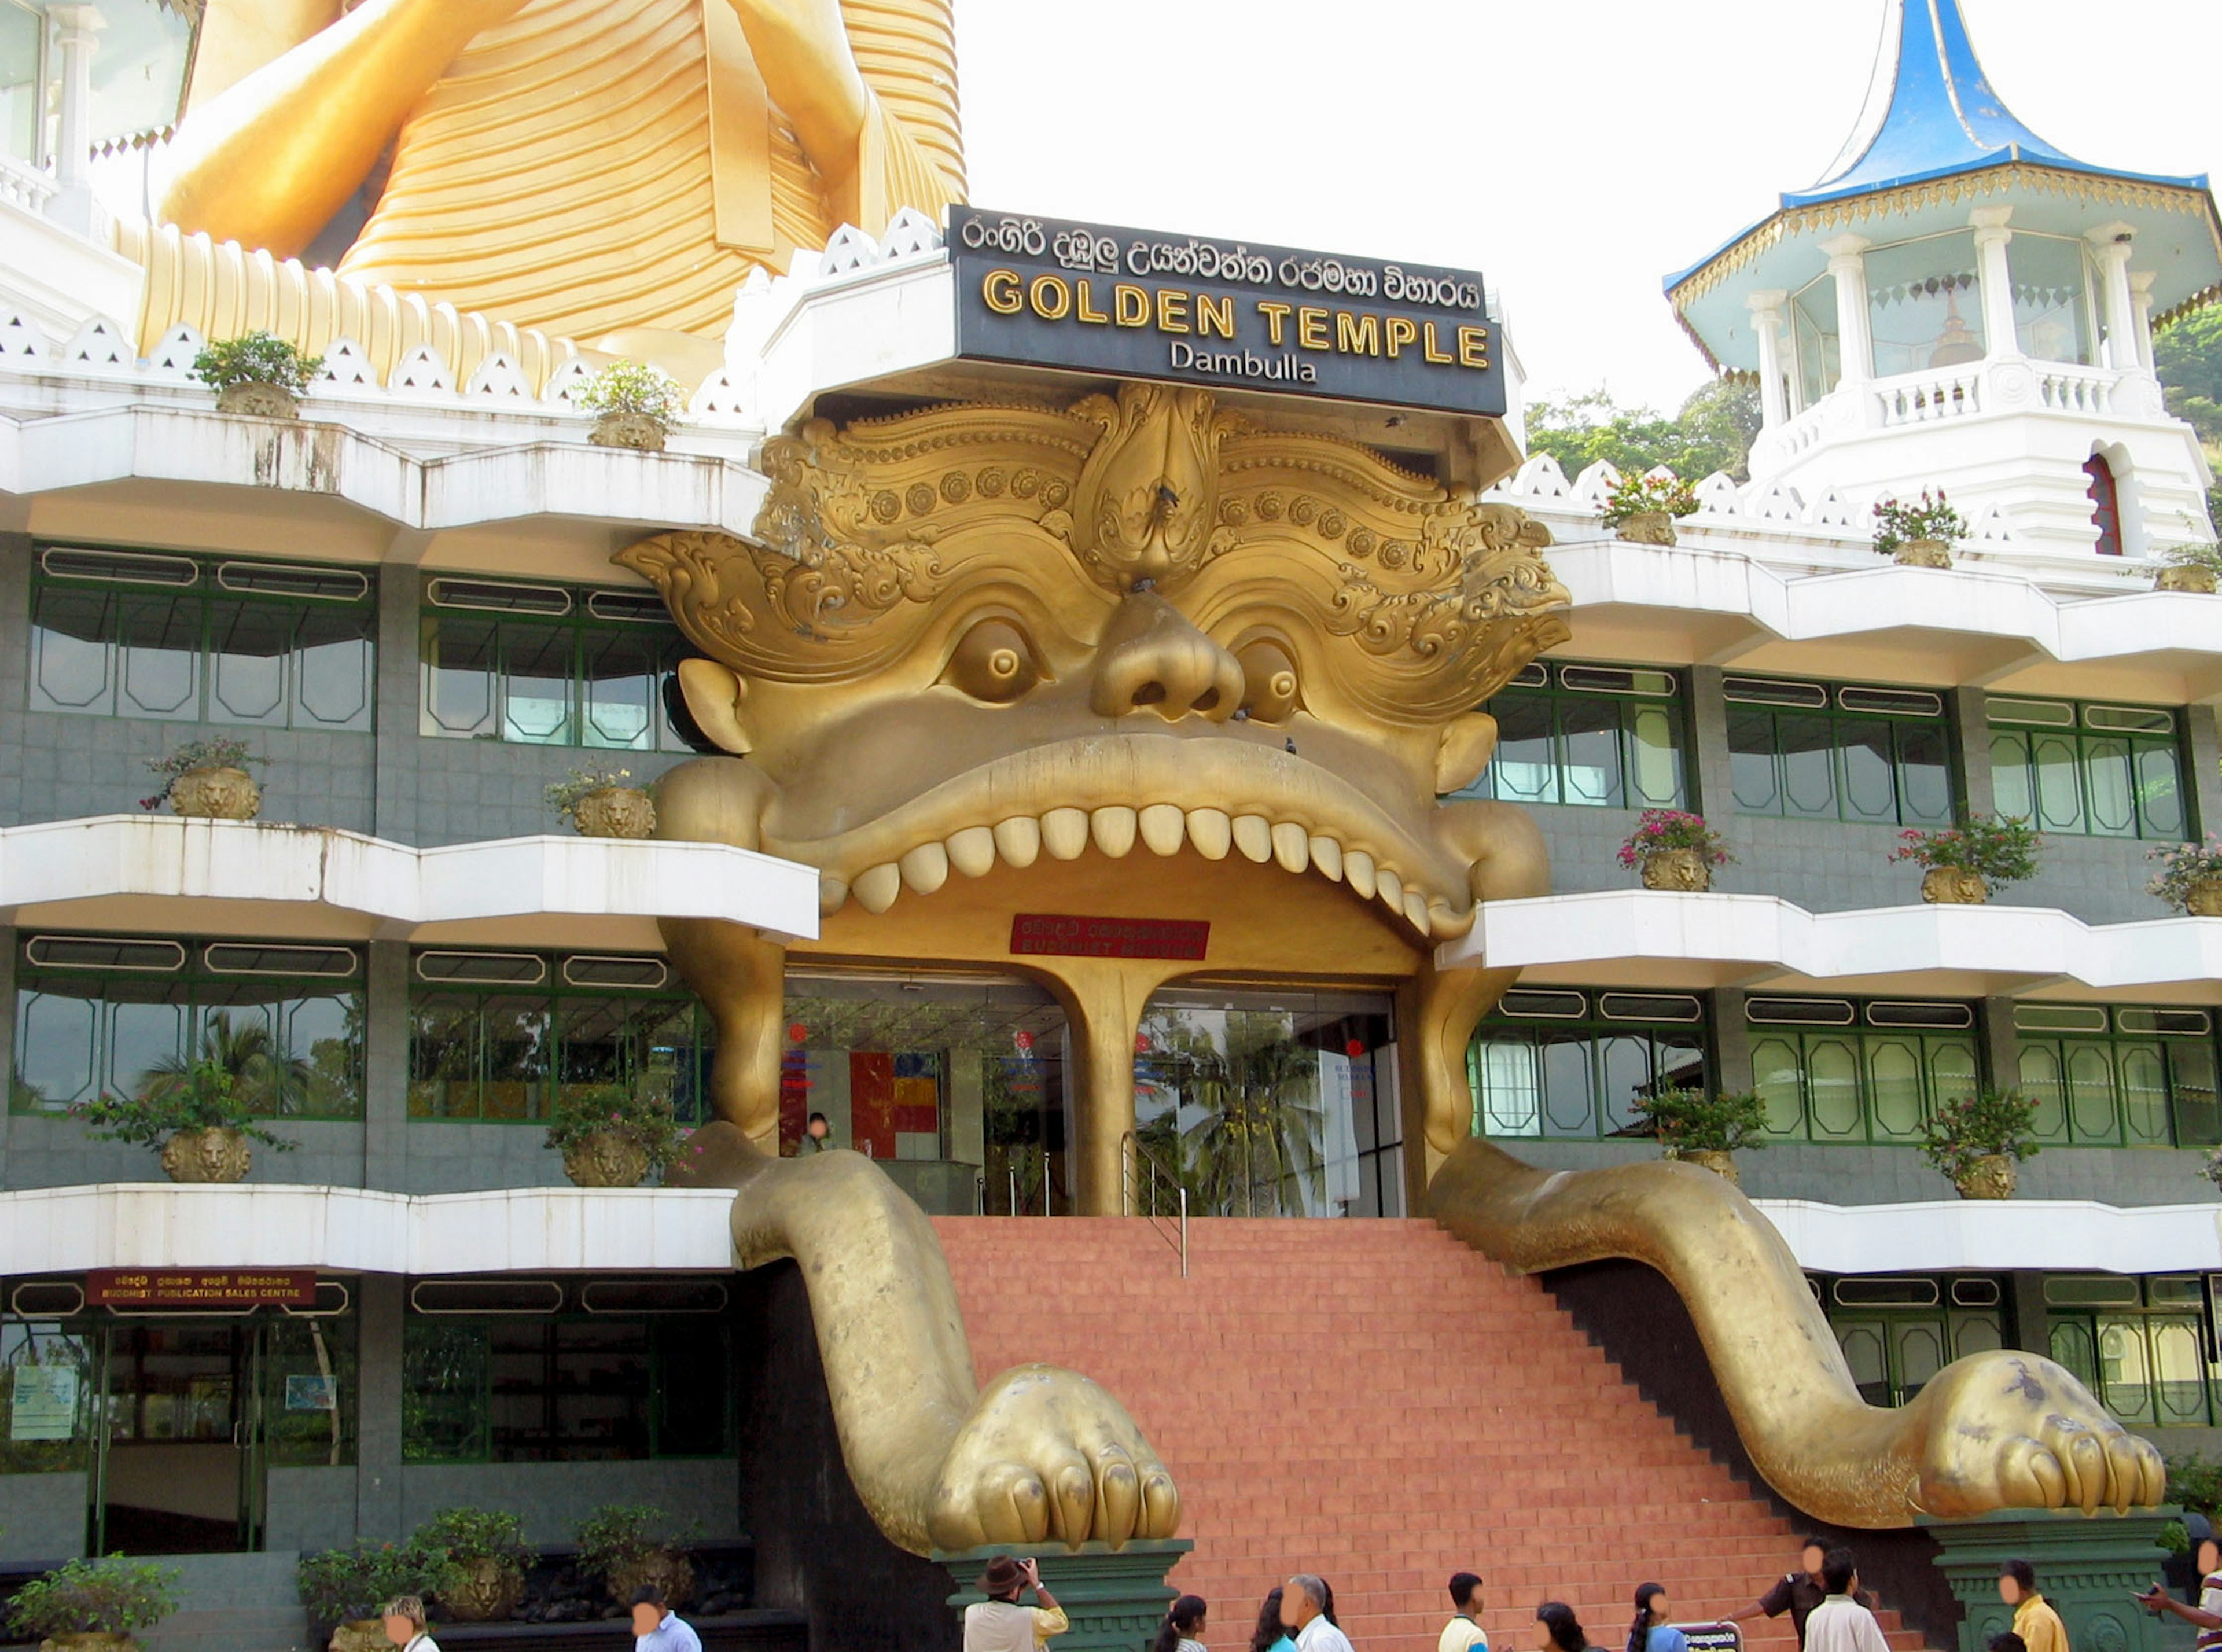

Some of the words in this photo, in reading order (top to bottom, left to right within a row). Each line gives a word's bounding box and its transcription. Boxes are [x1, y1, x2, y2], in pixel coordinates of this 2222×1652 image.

[1127, 238, 1274, 284] උයන්වත්ත
[1278, 255, 1378, 297] රජමහා
[1383, 265, 1480, 310] විහාරය
[981, 268, 1237, 340] GOLDEN
[1256, 300, 1491, 370] TEMPLE
[1170, 340, 1319, 384] Dambulla
[101, 1289, 152, 1298] BUDDHIST
[157, 1289, 222, 1298] PUBLICATION
[225, 1289, 258, 1298] SALES
[260, 1289, 301, 1298] CENTRE
